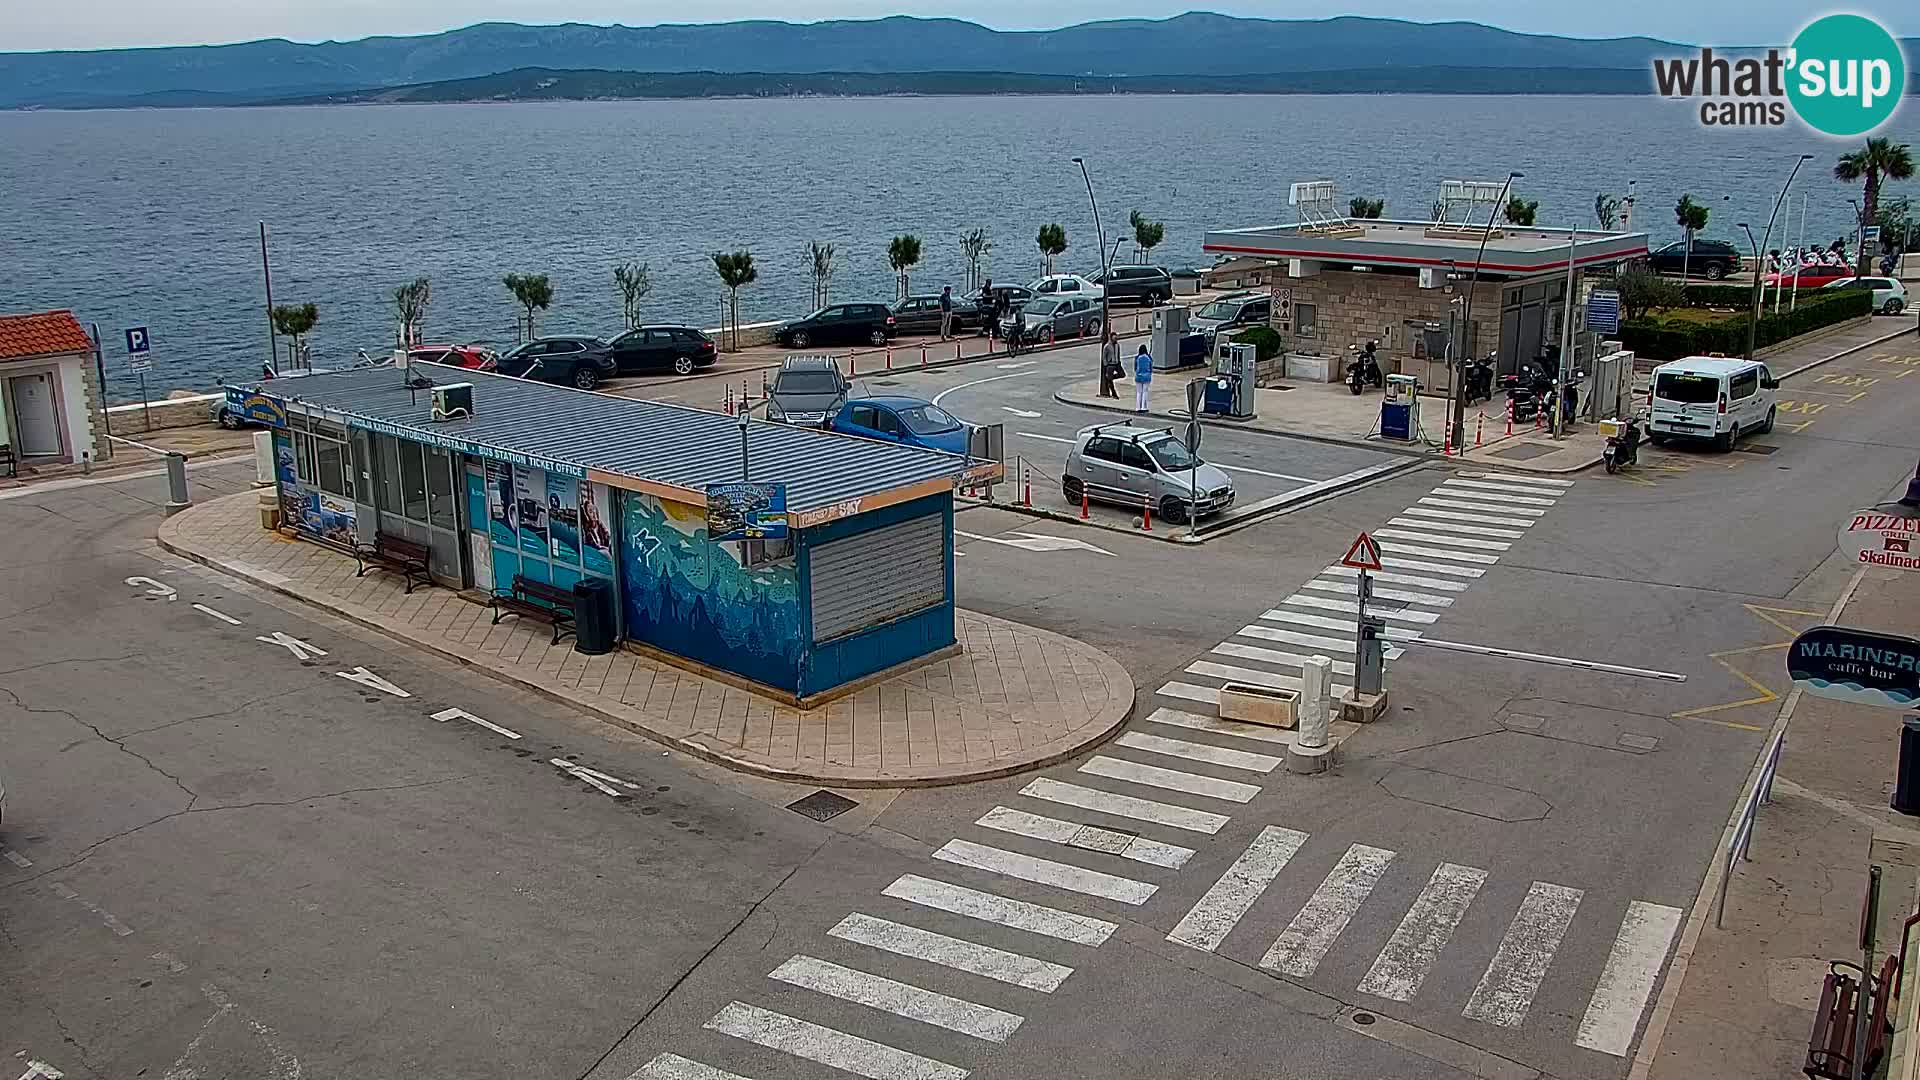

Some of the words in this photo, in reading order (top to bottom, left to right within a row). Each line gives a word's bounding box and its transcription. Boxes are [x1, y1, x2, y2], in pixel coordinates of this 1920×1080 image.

[130, 331, 143, 349] P
[1813, 374, 1880, 387] TAXI
[396, 427, 436, 445] AUTOBUSNA
[436, 437, 468, 451] POSTAJA
[478, 446, 494, 457] BUS
[495, 449, 527, 465] STATION
[528, 456, 555, 471] TICKET
[556, 463, 583, 477] OFFICE
[1881, 531, 1916, 540] GRILL
[1828, 662, 1864, 675] caffe
[1870, 665, 1896, 680] bar
